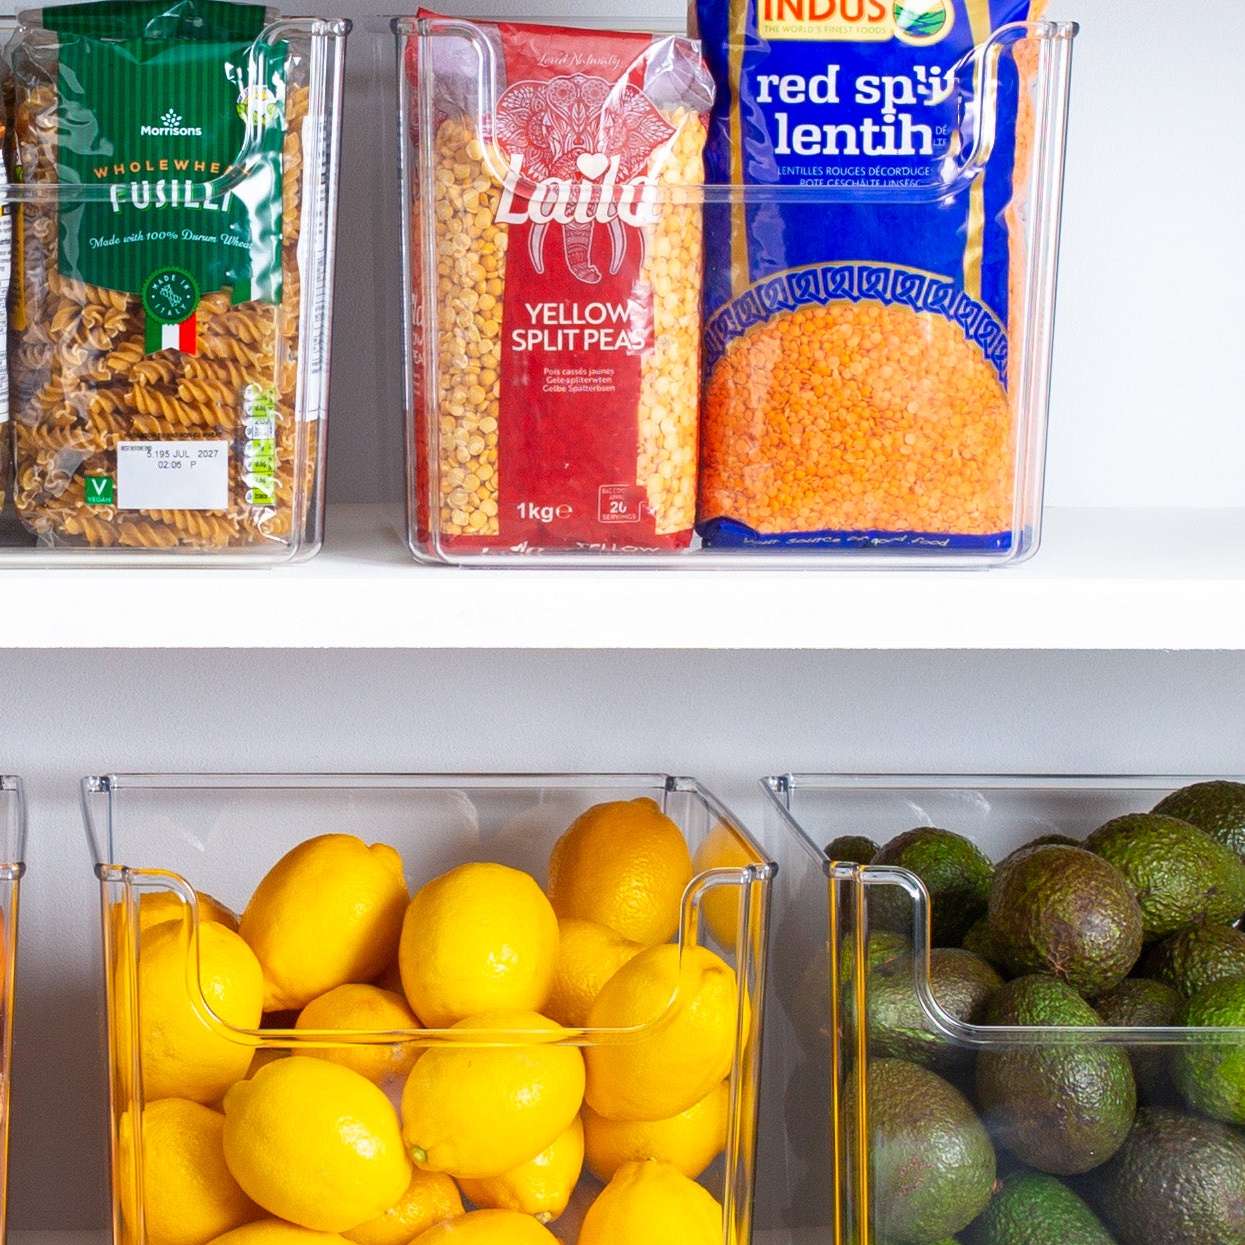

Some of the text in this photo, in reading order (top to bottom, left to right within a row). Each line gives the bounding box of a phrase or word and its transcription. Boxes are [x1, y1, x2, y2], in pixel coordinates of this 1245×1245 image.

[764, 25, 779, 33] THE
[781, 25, 821, 34] WORLD'S
[824, 25, 853, 34] FINEST
[756, 65, 839, 104] red
[141, 125, 202, 137] Morrisons
[826, 166, 866, 176] ROUGES
[110, 179, 233, 213] FUSILLI
[494, 153, 662, 226] Laila
[89, 234, 120, 249] Made
[123, 230, 144, 243] with
[146, 230, 178, 240] 100%
[181, 229, 217, 243] Durum
[151, 274, 190, 290] MADE IN
[155, 303, 187, 316] ITALY
[525, 302, 632, 326] YELLOW
[511, 328, 645, 352] SPLIT PEAS
[172, 449, 219, 458] JUL 2027
[190, 460, 197, 468] P
[517, 502, 554, 523] 1kg
